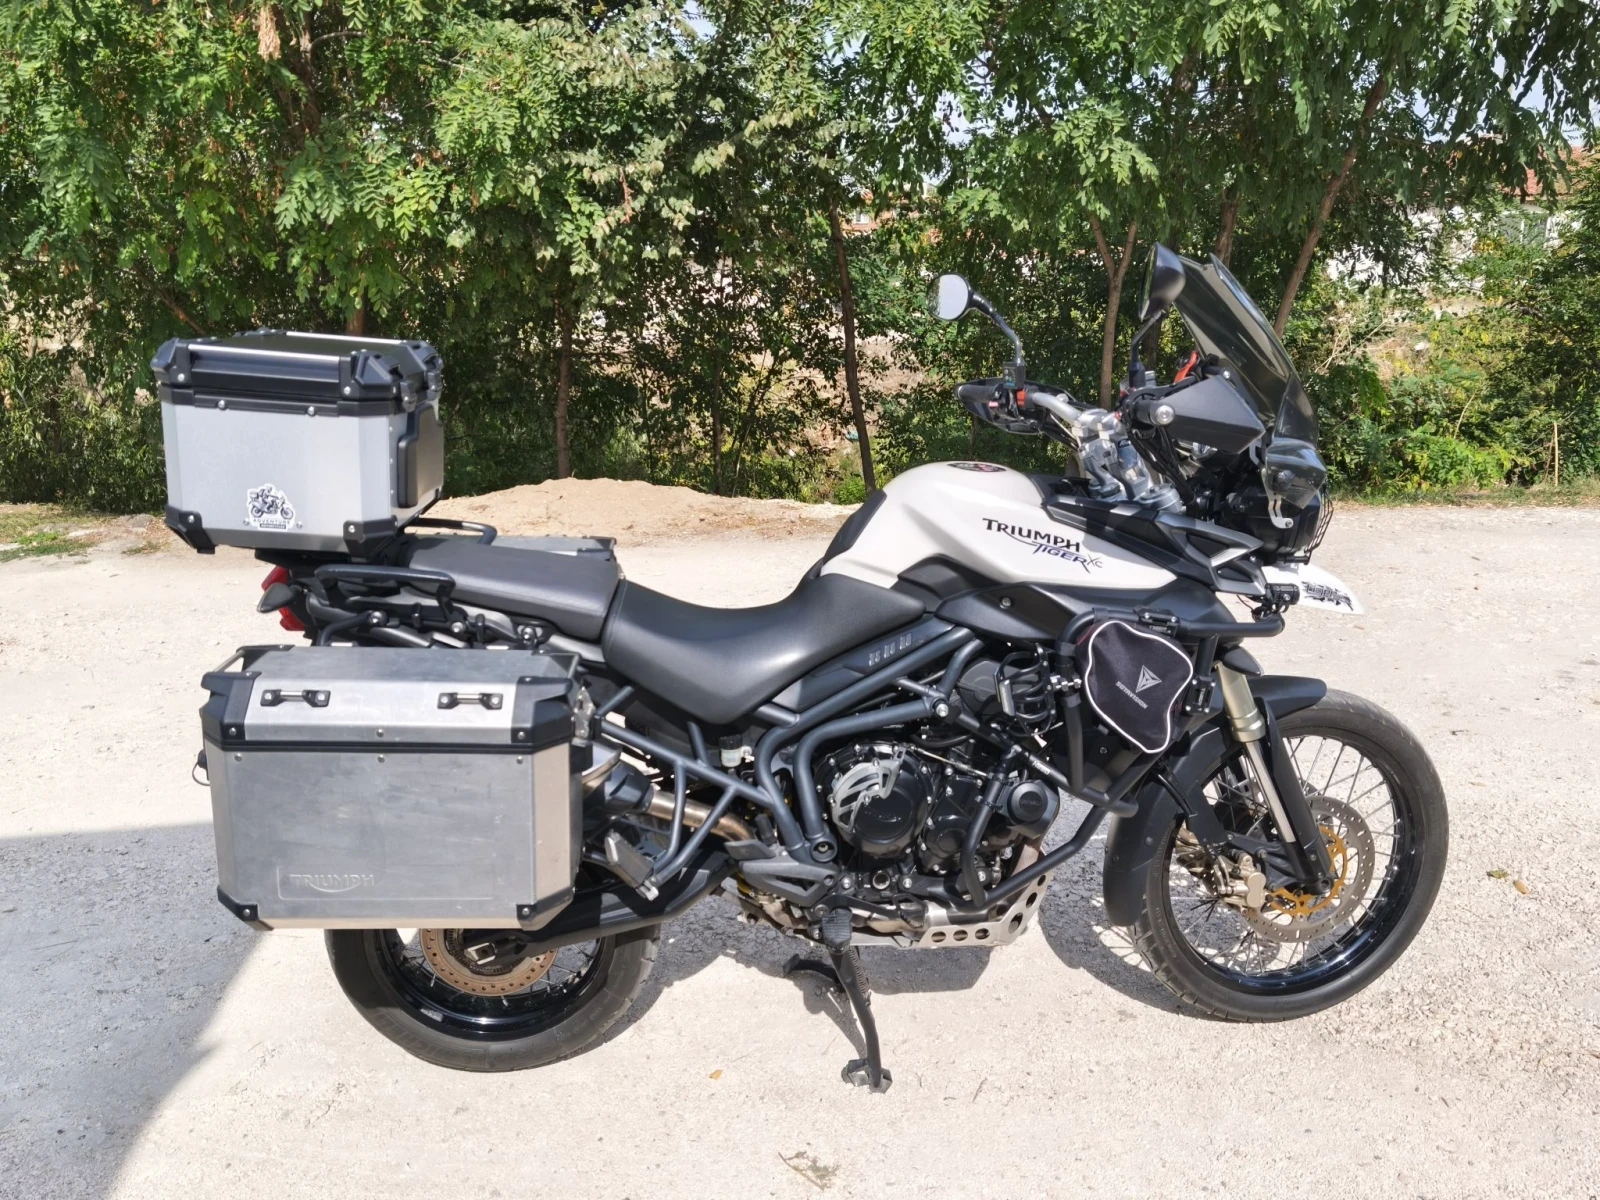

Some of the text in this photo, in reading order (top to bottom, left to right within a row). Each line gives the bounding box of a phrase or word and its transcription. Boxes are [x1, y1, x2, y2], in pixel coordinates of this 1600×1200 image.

[982, 518, 1080, 553] TRIUMPH
[1032, 541, 1091, 574] TIGER
[289, 874, 374, 892] TRIUMPH
